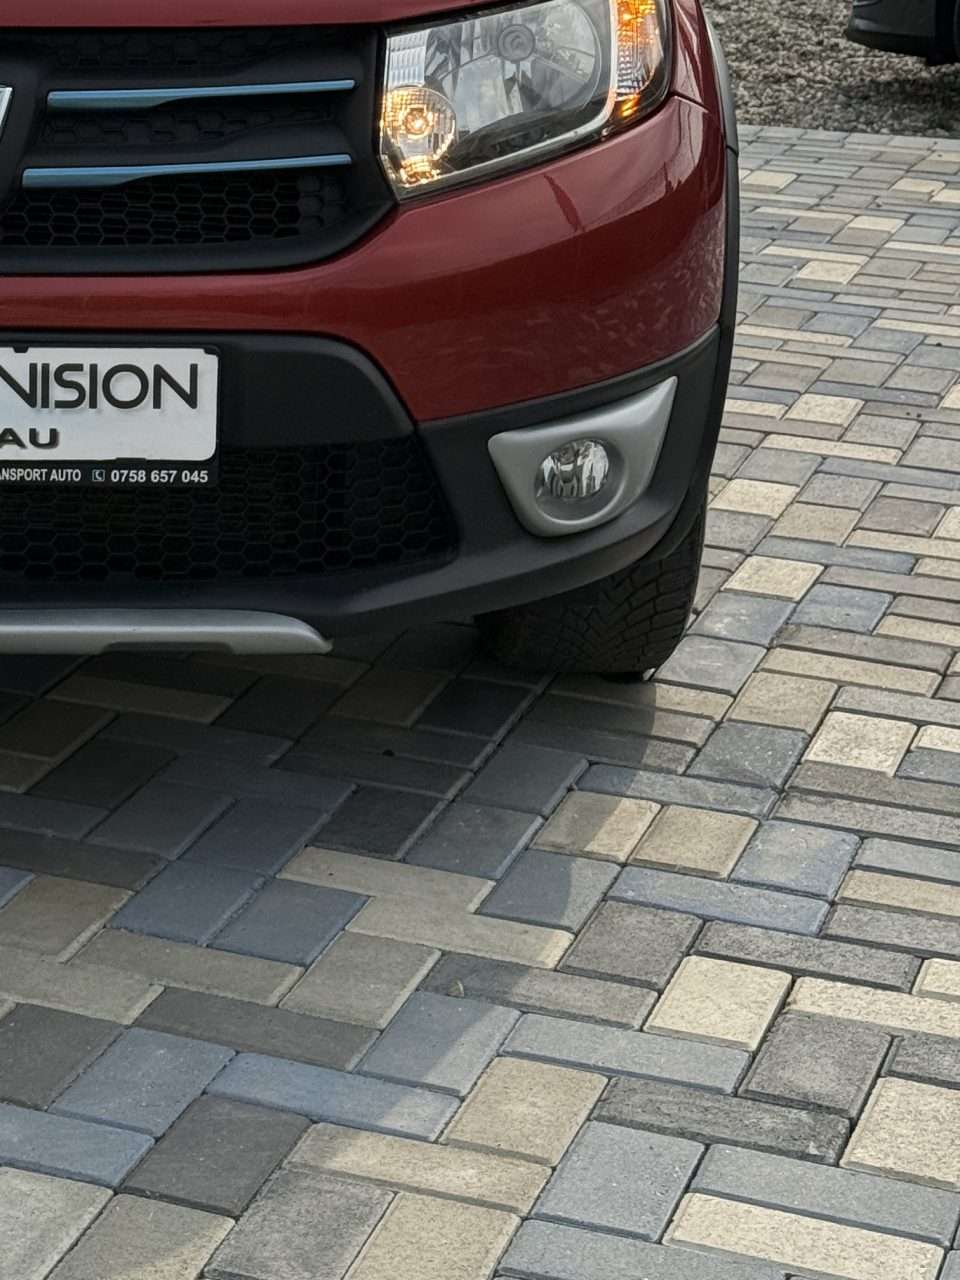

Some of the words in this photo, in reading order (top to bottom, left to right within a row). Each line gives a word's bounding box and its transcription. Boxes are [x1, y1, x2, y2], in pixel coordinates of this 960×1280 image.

[50, 468, 81, 481] AUTO
[111, 469, 146, 483] 0758
[150, 470, 177, 483] 657
[181, 471, 208, 483] 045
